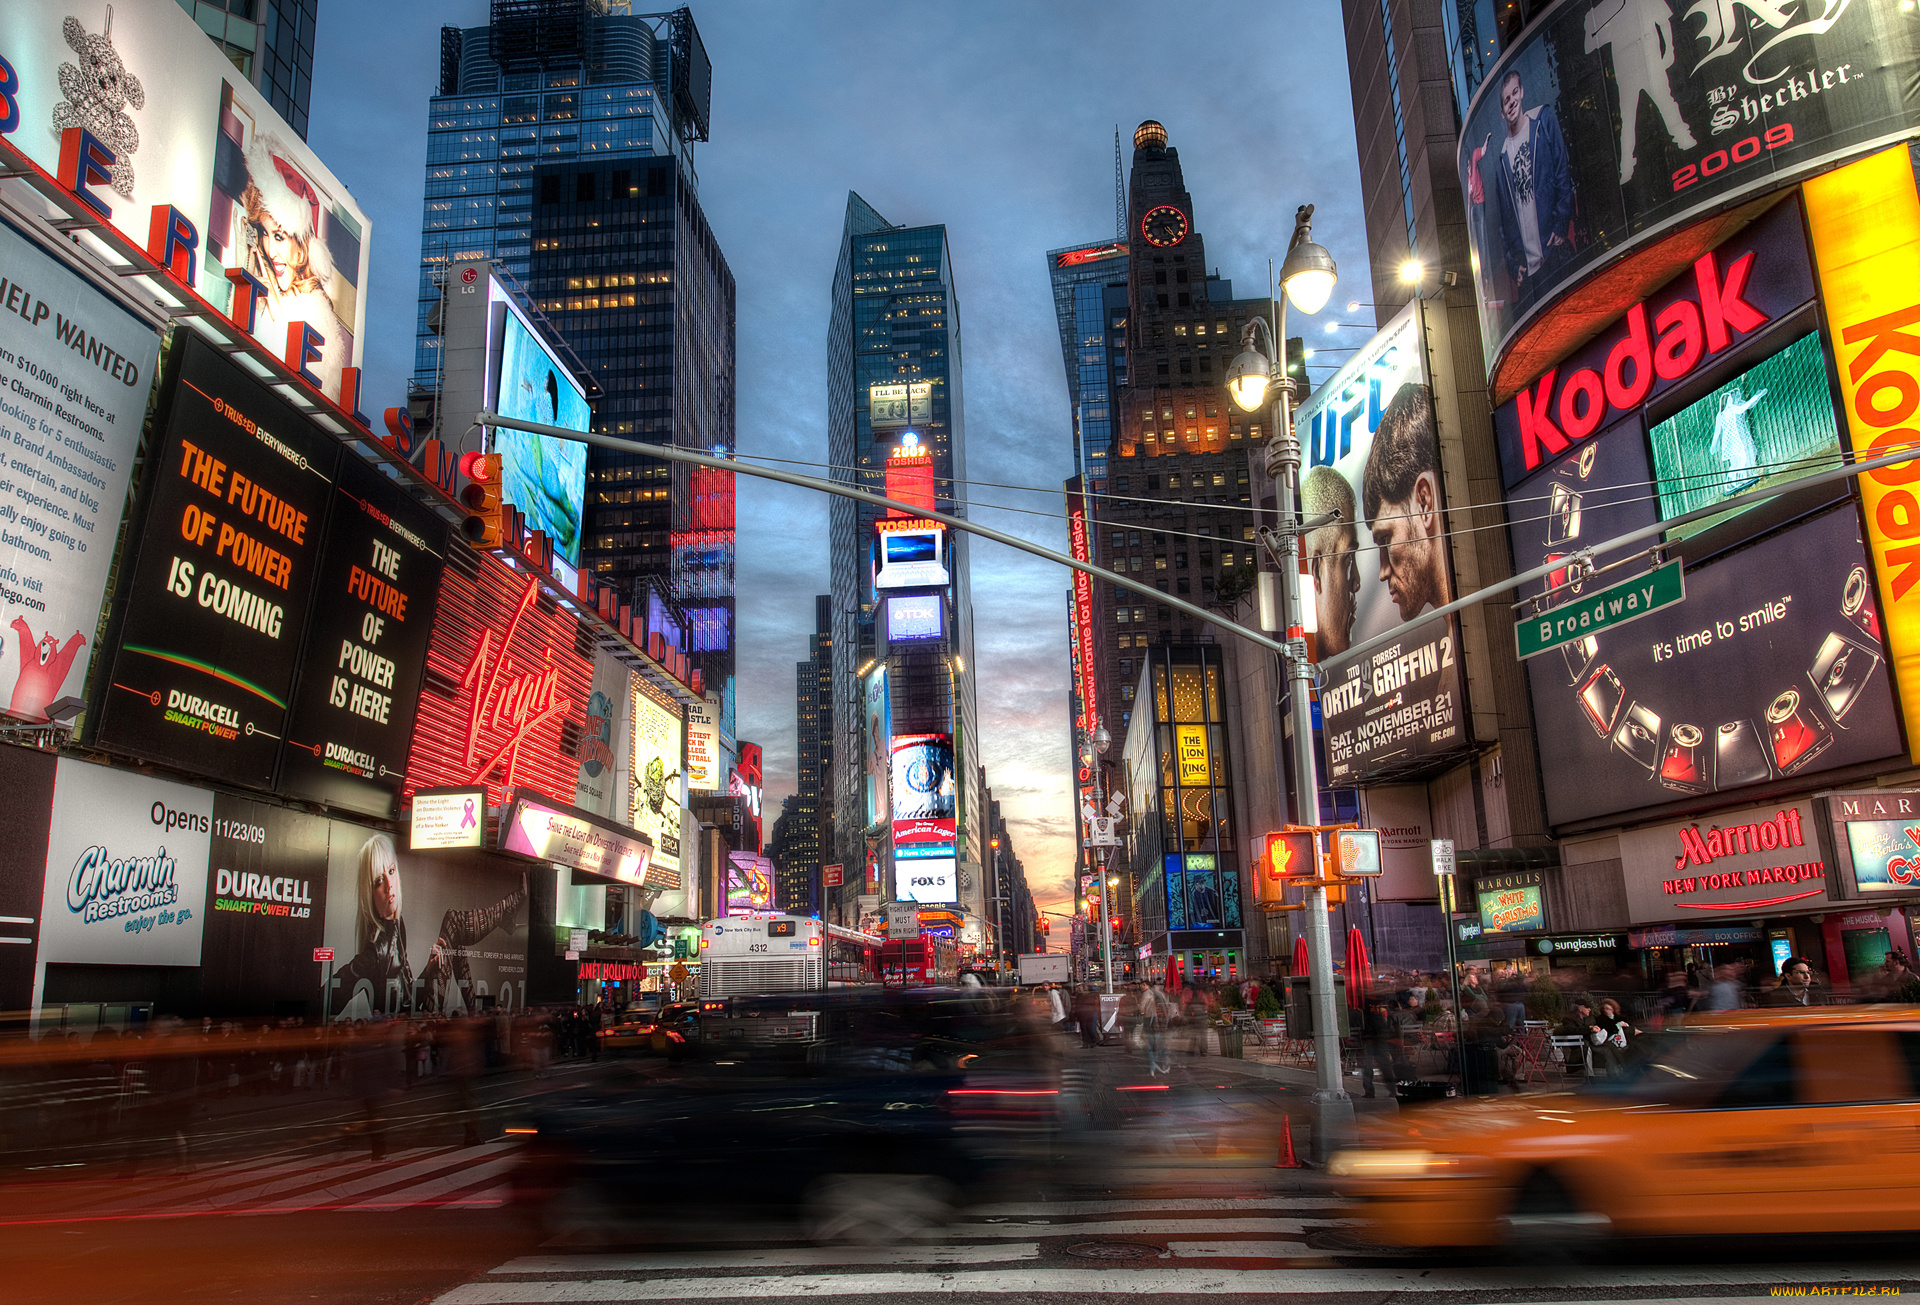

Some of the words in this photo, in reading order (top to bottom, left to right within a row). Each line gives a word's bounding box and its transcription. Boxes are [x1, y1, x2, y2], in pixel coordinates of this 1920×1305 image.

[1706, 84, 1737, 109] By
[1671, 123, 1794, 191] 2009
[461, 286, 475, 294] LG
[57, 313, 139, 387] WANTED
[1515, 250, 1769, 471] Kodak
[17, 356, 58, 389] $10,000
[60, 383, 83, 404] right
[85, 396, 105, 418] here
[107, 412, 115, 424] at
[11, 379, 53, 412] Charmin
[55, 404, 105, 442] Restrooms.
[1298, 397, 1326, 426] ULTIMATE
[1310, 346, 1397, 468] UFC
[39, 419, 53, 437] for
[55, 429, 62, 442] 5
[64, 434, 117, 473] enthusiastic
[256, 426, 299, 465] EVERYWHERE
[892, 446, 926, 458] 2009
[13, 432, 45, 457] Brand
[46, 449, 106, 491] Ambassadors
[886, 456, 932, 466] TOSHIBA
[11, 458, 58, 492] entertain,
[60, 483, 78, 502] and
[79, 491, 99, 514] blog
[180, 439, 226, 497] THE
[228, 470, 308, 545] FUTURE
[17, 484, 70, 523] experience.
[73, 512, 95, 533] Must
[20, 514, 48, 539] enjoy
[49, 527, 75, 552] going
[77, 542, 87, 554] to
[389, 518, 420, 547] EVERYWHERE
[875, 519, 946, 534] TOSHIBA
[2, 529, 52, 562] bathroom.
[181, 504, 216, 547] OF
[216, 522, 292, 590] POWER
[371, 538, 401, 581] THE
[23, 576, 43, 594] visit
[166, 556, 195, 598] IS
[197, 571, 284, 639] COMING
[348, 564, 409, 621] FUTURE
[903, 608, 934, 619] TDK
[1080, 604, 1090, 625] for
[1540, 584, 1654, 642] Broadway
[361, 612, 384, 645] OF
[1653, 642, 1673, 662] it's
[1676, 630, 1712, 654] time
[1716, 621, 1734, 639] to
[1083, 627, 1093, 672] name
[1372, 643, 1401, 667] FORREST
[338, 640, 395, 689] POWER
[1347, 664, 1360, 680] TITO
[1372, 642, 1439, 697] GRIFFIN
[1440, 636, 1454, 669] 2
[329, 675, 349, 709] IS
[349, 685, 392, 725] HERE
[1088, 678, 1097, 708] new
[1322, 678, 1363, 719] ORTIZ
[167, 689, 240, 729] DURACELL
[1330, 729, 1355, 751] SAT.
[1357, 699, 1432, 741] NOVEMBER
[1435, 691, 1452, 711] 21
[1183, 736, 1200, 744] THE
[1331, 747, 1352, 764] LIVE
[1354, 739, 1370, 754] ON
[1373, 707, 1453, 749] PAY-PER-VIEW
[1430, 726, 1456, 743] UFC.COM
[325, 742, 375, 771] DURACELL
[1181, 747, 1204, 761] LION
[362, 769, 374, 779] LAB
[1182, 763, 1206, 778] KING
[589, 786, 603, 800] SQUARE
[150, 801, 209, 833] Opens
[215, 819, 265, 844] 11/23/09
[895, 825, 932, 839] American
[932, 826, 955, 837] Lager
[1380, 825, 1421, 837] Marriott
[662, 836, 678, 851] CIRCA
[920, 848, 954, 856] Corporation
[1675, 808, 1804, 870] Marriott
[1857, 832, 1890, 852] Irving
[1872, 838, 1913, 860] Berlin's
[67, 845, 175, 914] Charmin
[216, 868, 311, 904] DURACELL
[911, 877, 934, 886] FOX
[936, 877, 946, 886] 5
[1477, 872, 1540, 890] MARQUIS
[1663, 877, 1696, 895] NEW
[1699, 871, 1743, 890] YORK
[84, 884, 178, 924] Restrooms!
[290, 906, 310, 918] LAB
[1498, 889, 1525, 907] WHITE
[125, 911, 155, 934] enjoy
[158, 908, 175, 925] the
[176, 908, 192, 922] go.
[895, 916, 910, 924] MUST
[1492, 900, 1539, 930] CHRISTMAS
[1842, 916, 1855, 925] THE
[1855, 915, 1882, 925] MUSICAL
[749, 944, 768, 952] 4312
[1554, 939, 1598, 952] sunglass
[1599, 938, 1616, 948] hut
[1644, 934, 1654, 946] BOX
[1654, 932, 1675, 944] OFFICE
[1733, 931, 1762, 940] OFFICE
[603, 963, 647, 980] HOLLYWOOD
